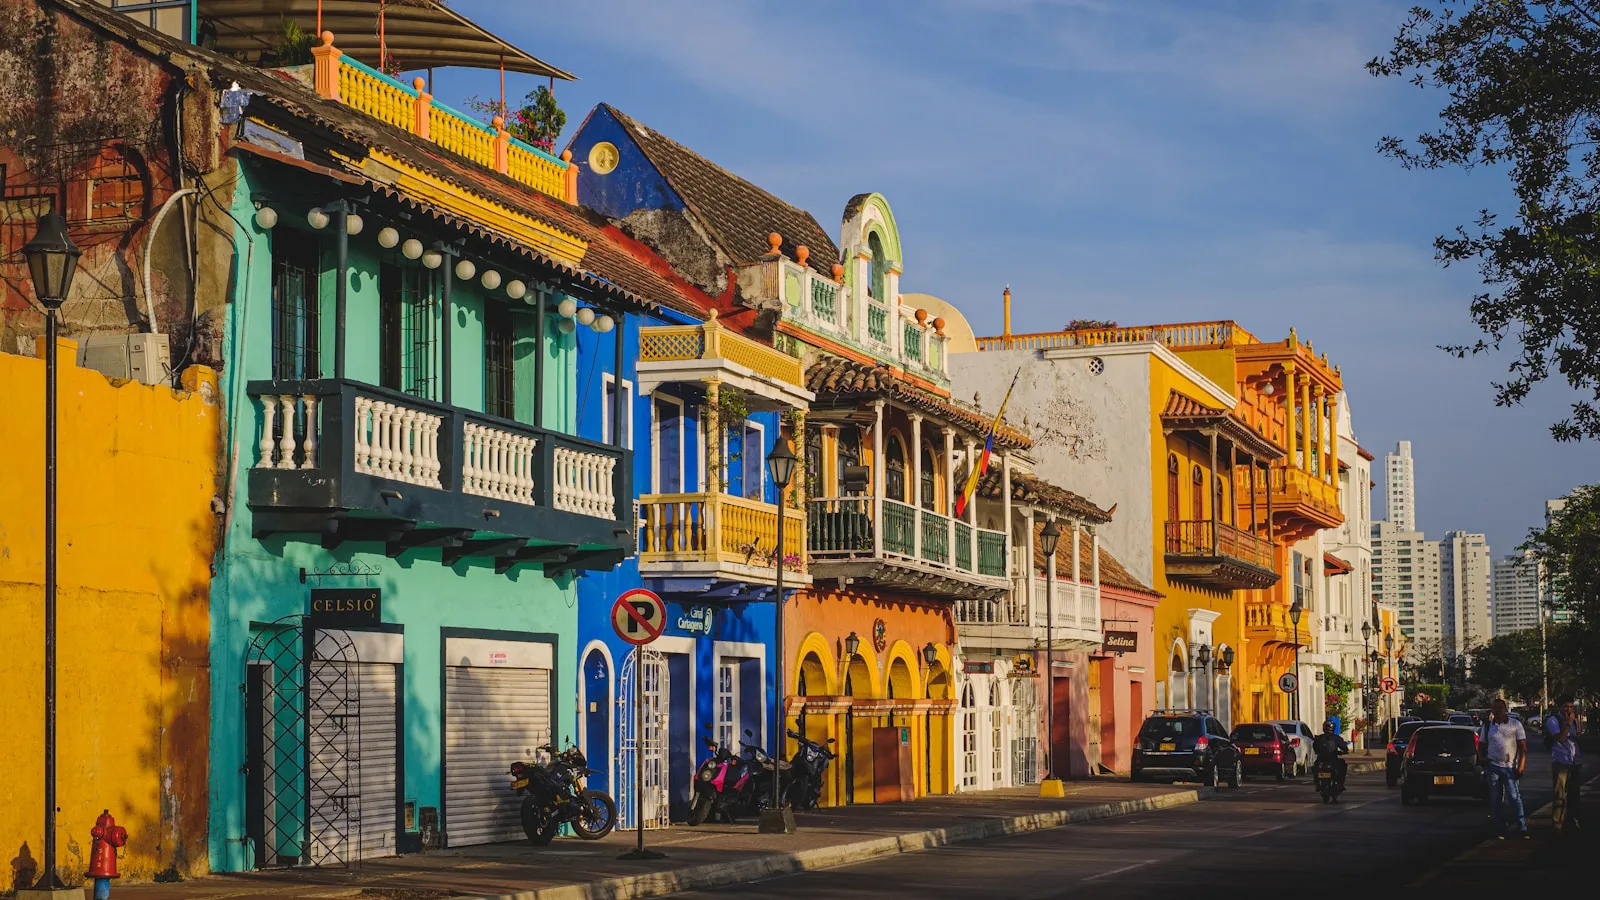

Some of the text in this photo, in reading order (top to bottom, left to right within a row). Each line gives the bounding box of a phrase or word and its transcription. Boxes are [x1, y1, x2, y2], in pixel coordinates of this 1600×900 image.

[628, 601, 654, 632] P
[678, 616, 703, 632] Cartagena
[1107, 636, 1135, 647] Selina
